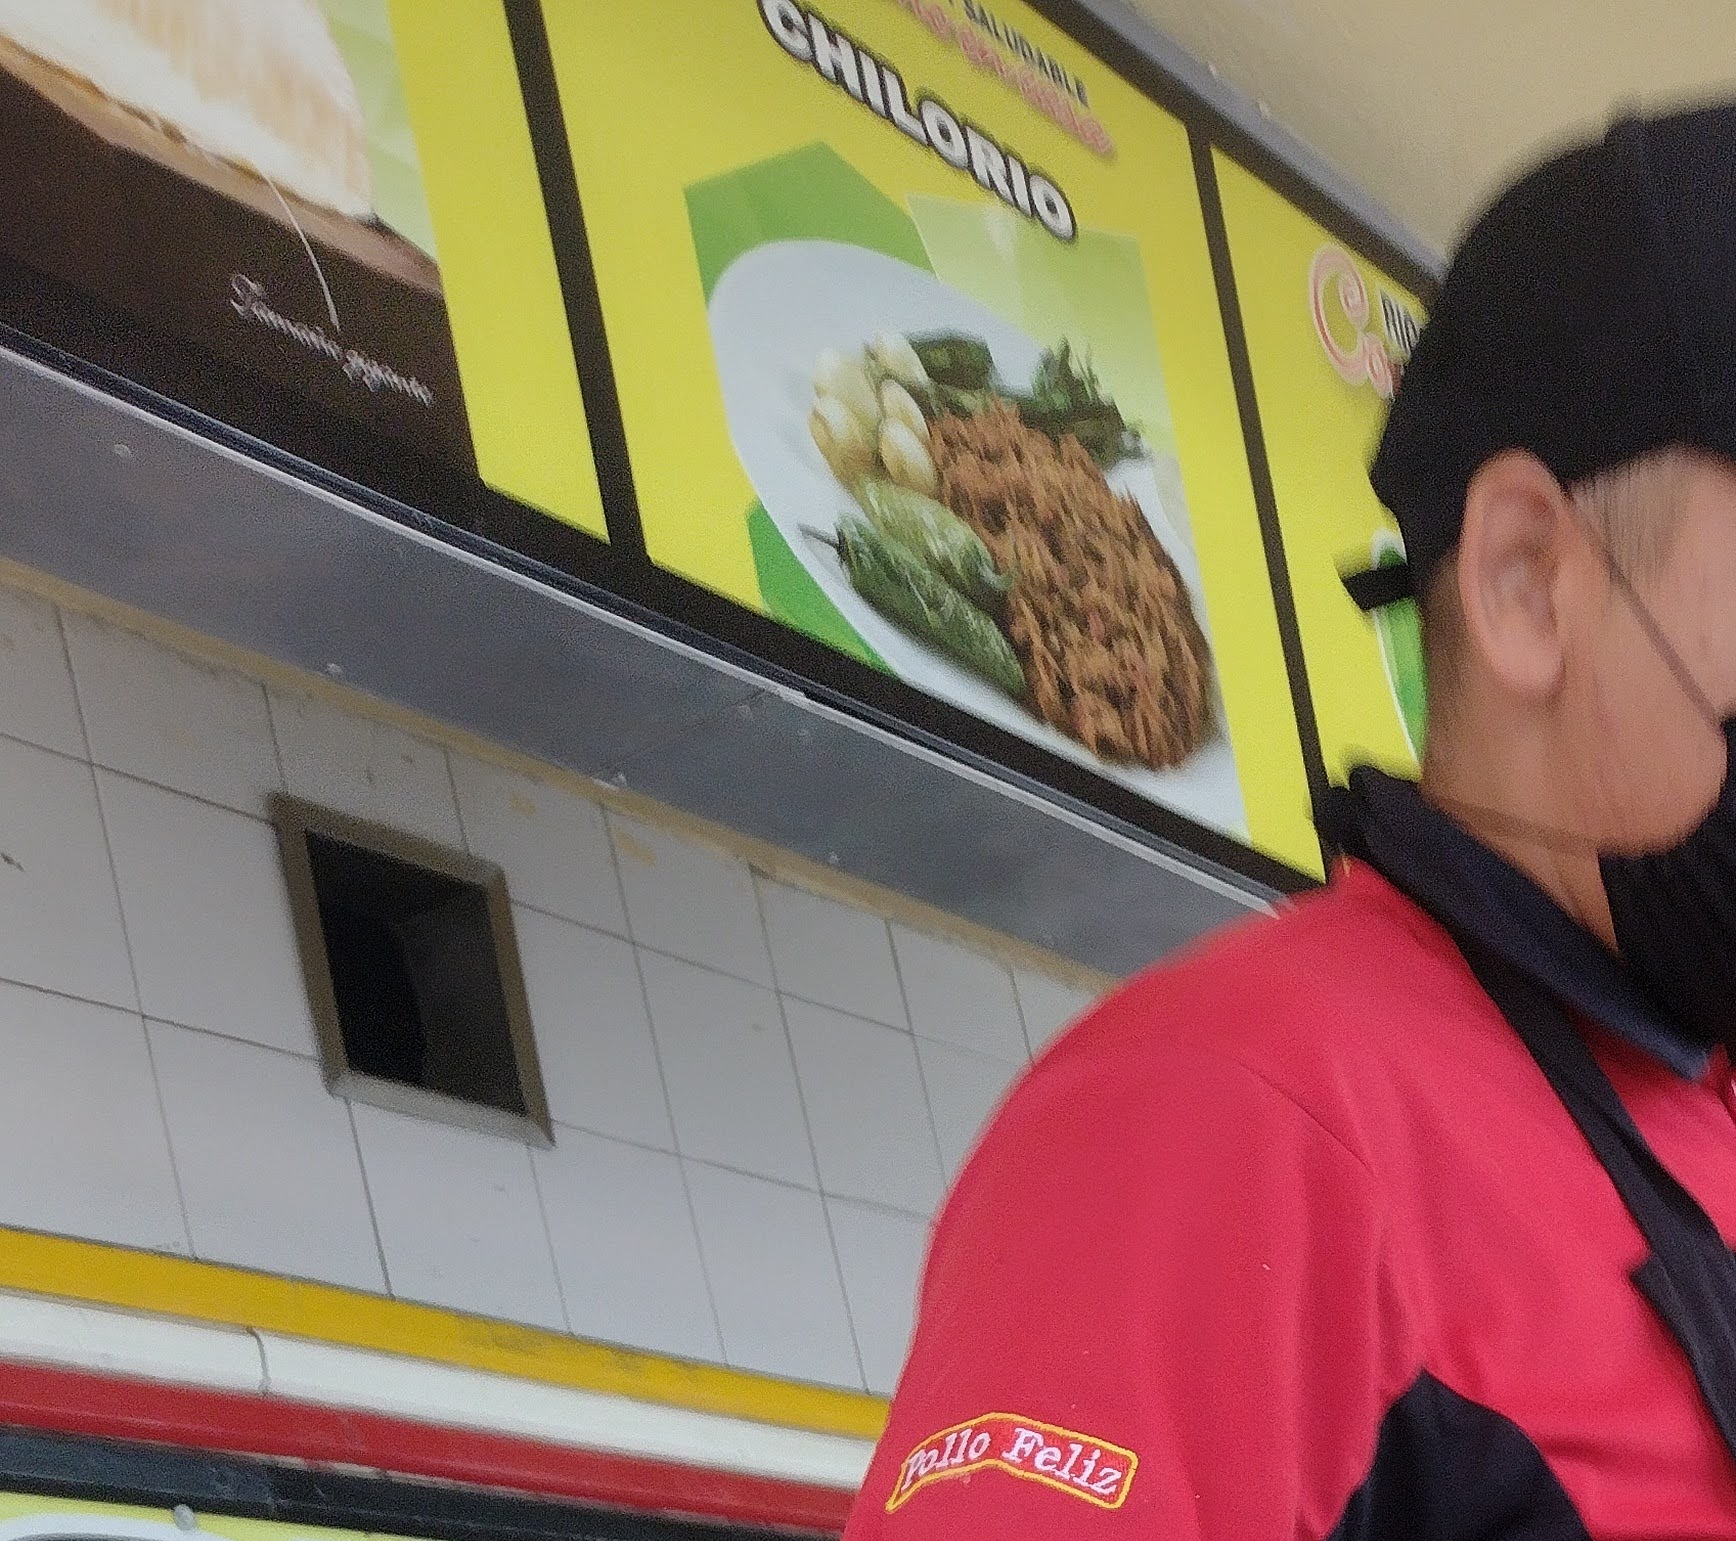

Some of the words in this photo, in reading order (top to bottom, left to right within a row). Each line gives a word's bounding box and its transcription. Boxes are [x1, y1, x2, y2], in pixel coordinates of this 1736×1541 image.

[758, 0, 1077, 242] CHILORIO
[900, 1428, 992, 1491] Pollo
[1001, 1427, 1123, 1495] Feliz
